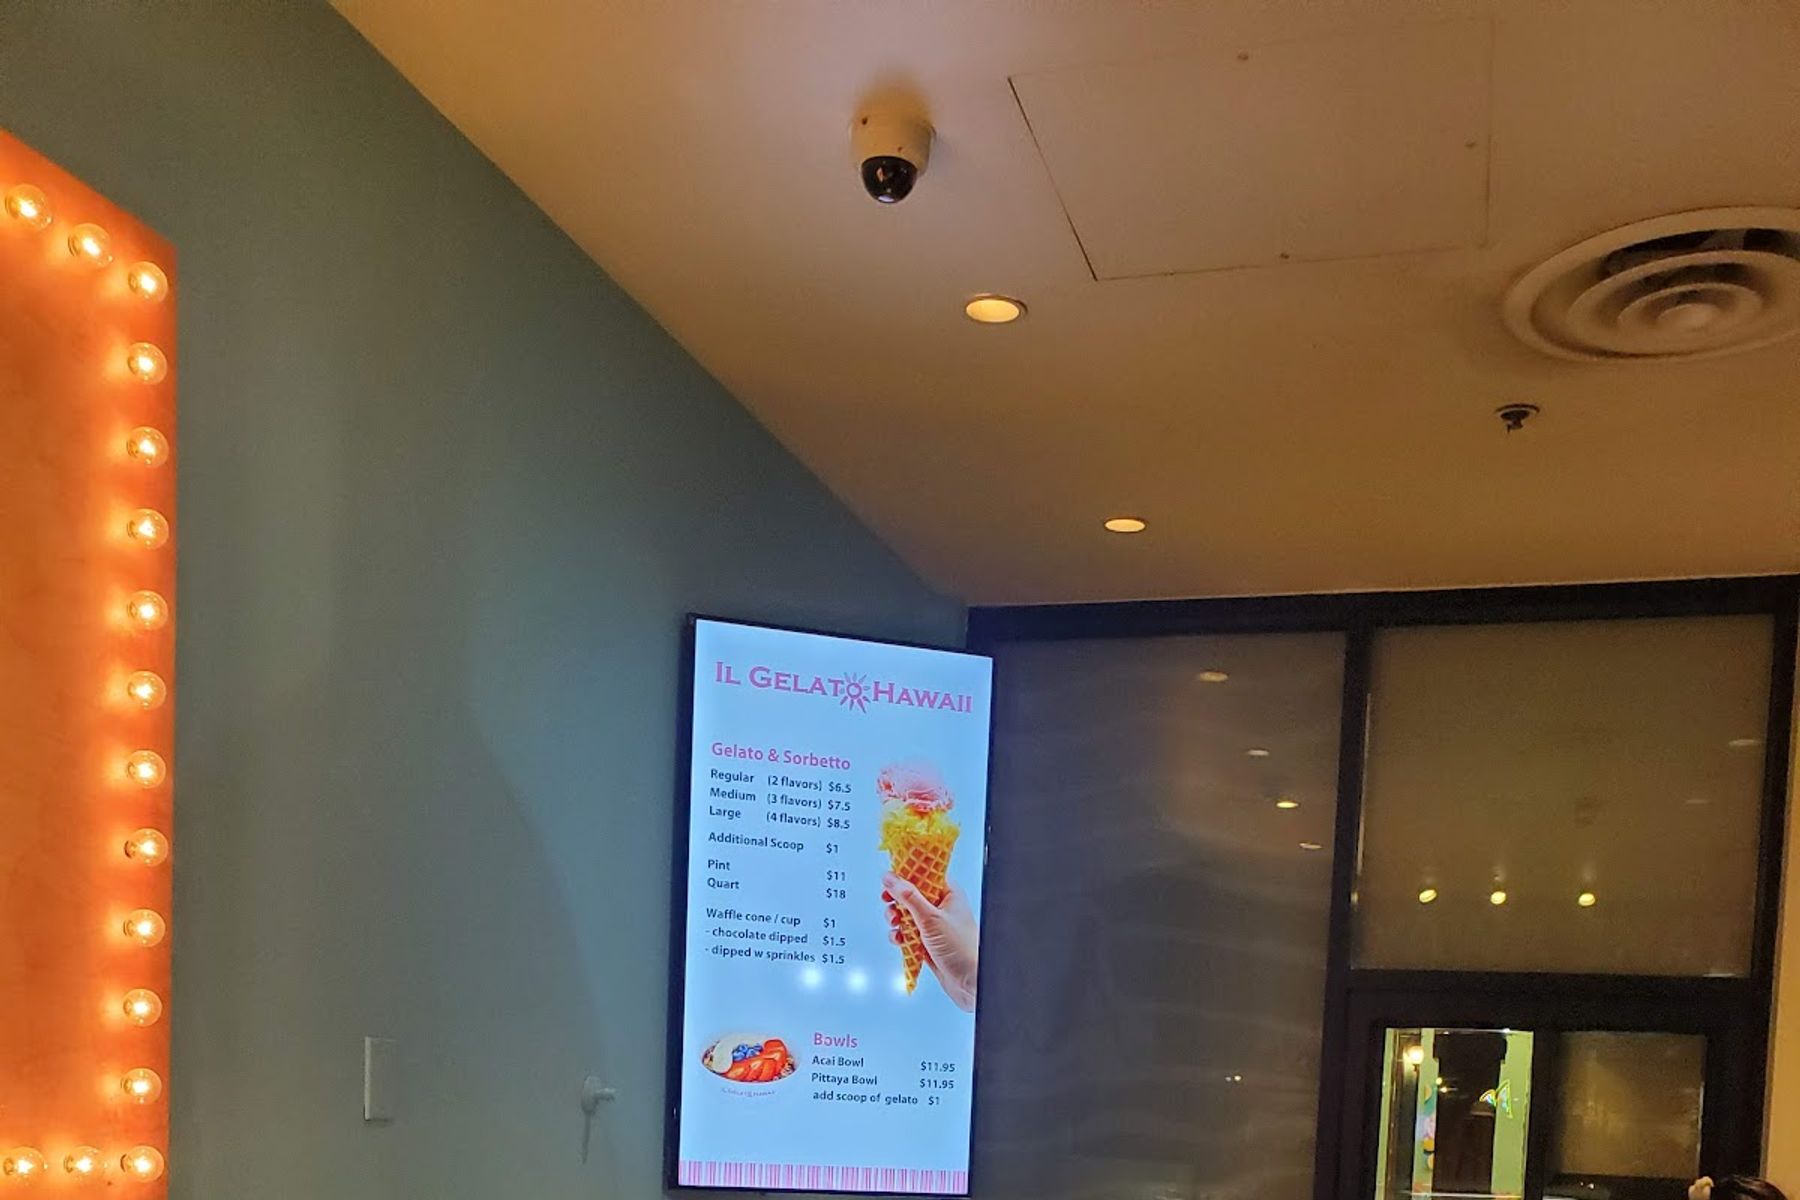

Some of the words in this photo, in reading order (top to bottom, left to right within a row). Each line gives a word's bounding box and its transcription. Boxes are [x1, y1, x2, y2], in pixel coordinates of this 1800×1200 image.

[711, 742, 763, 762] Gelato
[767, 749, 779, 763] &
[783, 750, 851, 770] Sorbetto
[710, 768, 754, 783] Regular
[767, 775, 779, 787] (2
[781, 776, 822, 792] flavors)
[828, 781, 852, 793] $6.5
[709, 787, 756, 801] Medium
[767, 793, 778, 805] (3
[780, 794, 822, 810] flavors)
[828, 799, 851, 812] $7.5
[709, 805, 742, 820] Large
[766, 811, 777, 823] (4
[779, 812, 821, 828] flavors)
[827, 817, 850, 829] $8.5
[708, 832, 768, 848] Additional
[770, 838, 804, 853] Scoop
[825, 842, 839, 854] $1
[707, 859, 731, 871] Pint
[826, 870, 846, 882] $11
[707, 877, 740, 890] Quart
[825, 887, 846, 899] $18
[706, 907, 743, 921] Waffle
[745, 912, 772, 924] cone
[781, 916, 801, 927] cup
[823, 917, 836, 928] $1
[712, 926, 767, 941] chocolate
[768, 931, 808, 945] dipped
[822, 935, 846, 947] $1.5
[711, 944, 752, 958] dipped
[754, 949, 763, 959] w
[766, 949, 816, 963] sprinkles
[821, 953, 845, 965] $1.5
[813, 1032, 858, 1049] Bowls
[811, 1054, 836, 1066] Acai
[838, 1056, 864, 1068] Bowl
[920, 1060, 956, 1073] $11.95
[811, 1072, 849, 1086] Pittaya
[851, 1075, 878, 1086] Bowl
[919, 1078, 954, 1089] $11.95
[812, 1090, 834, 1101] add
[836, 1093, 868, 1104] scoop
[869, 1093, 881, 1103] of
[884, 1094, 919, 1105] gelato
[928, 1095, 940, 1106] $1
